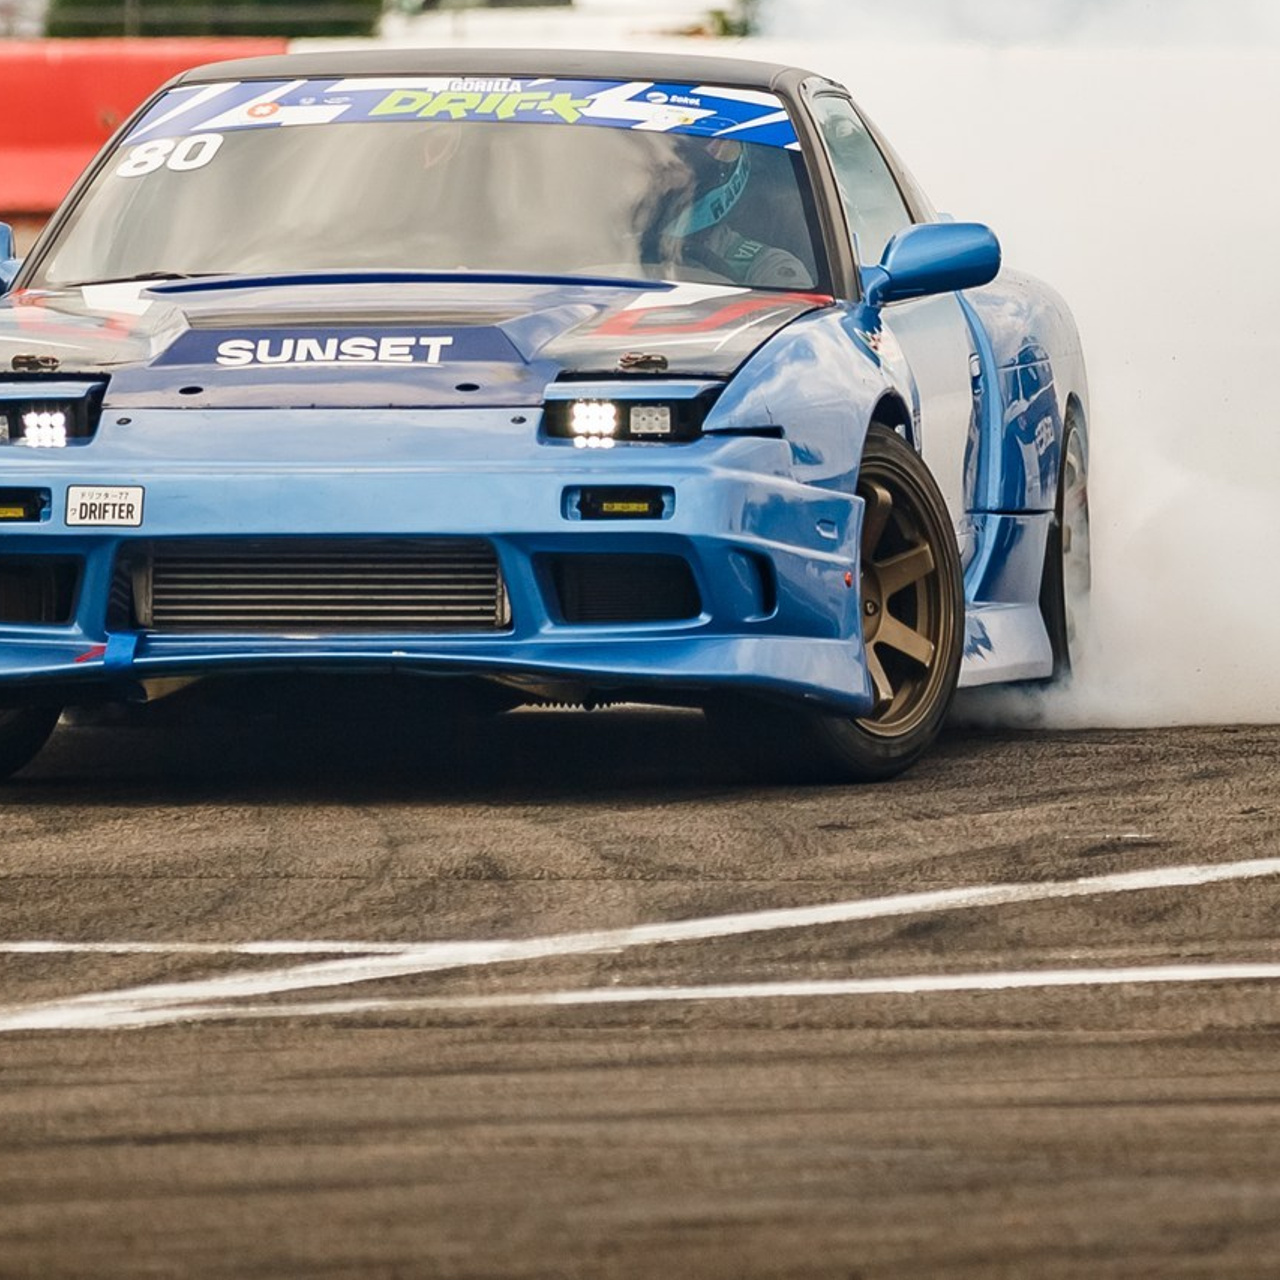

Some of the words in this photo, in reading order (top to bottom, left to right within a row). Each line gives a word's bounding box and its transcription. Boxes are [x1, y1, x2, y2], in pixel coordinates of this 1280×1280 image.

[451, 79, 522, 93] GORILLA
[116, 132, 224, 178] 80
[216, 336, 453, 365] SUNSET
[79, 502, 135, 520] DRIFTER
